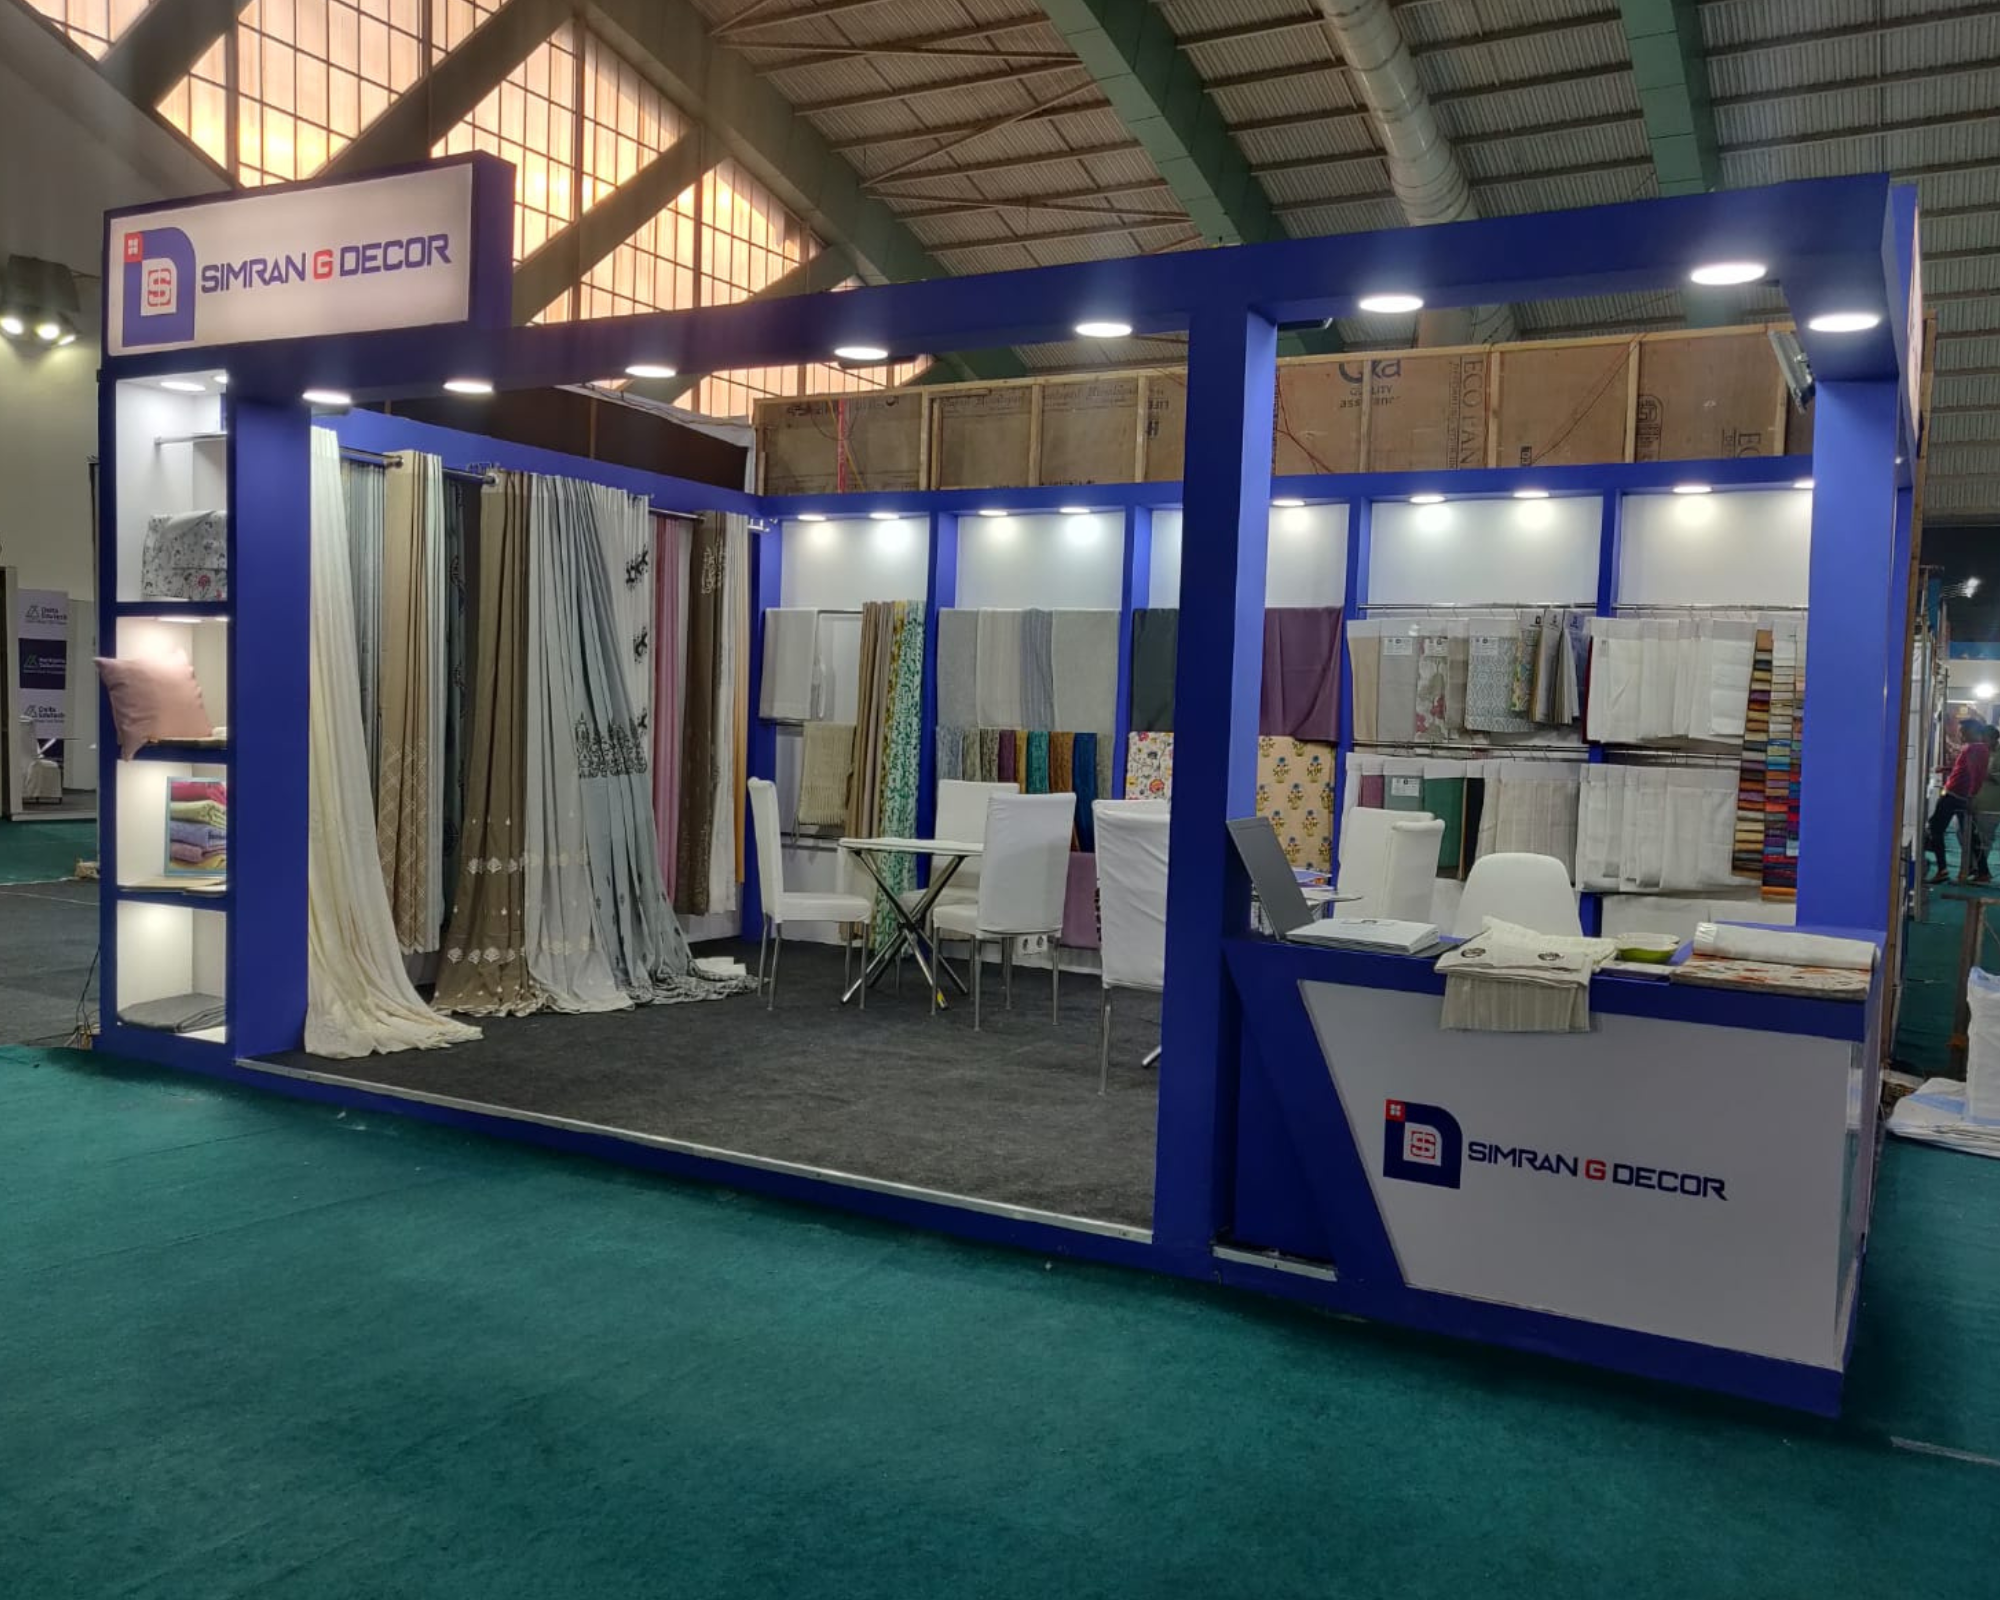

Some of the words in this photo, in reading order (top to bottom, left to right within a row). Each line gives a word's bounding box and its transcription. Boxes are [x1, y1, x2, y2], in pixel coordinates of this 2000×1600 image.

[200, 252, 306, 293] SIMRAN
[313, 249, 334, 280] G
[339, 233, 452, 276] DECOR
[1463, 360, 1484, 408] ECO
[1468, 1141, 1579, 1177] SIMRAN
[1584, 1159, 1607, 1180] G
[1612, 1163, 1728, 1201] DECOR
